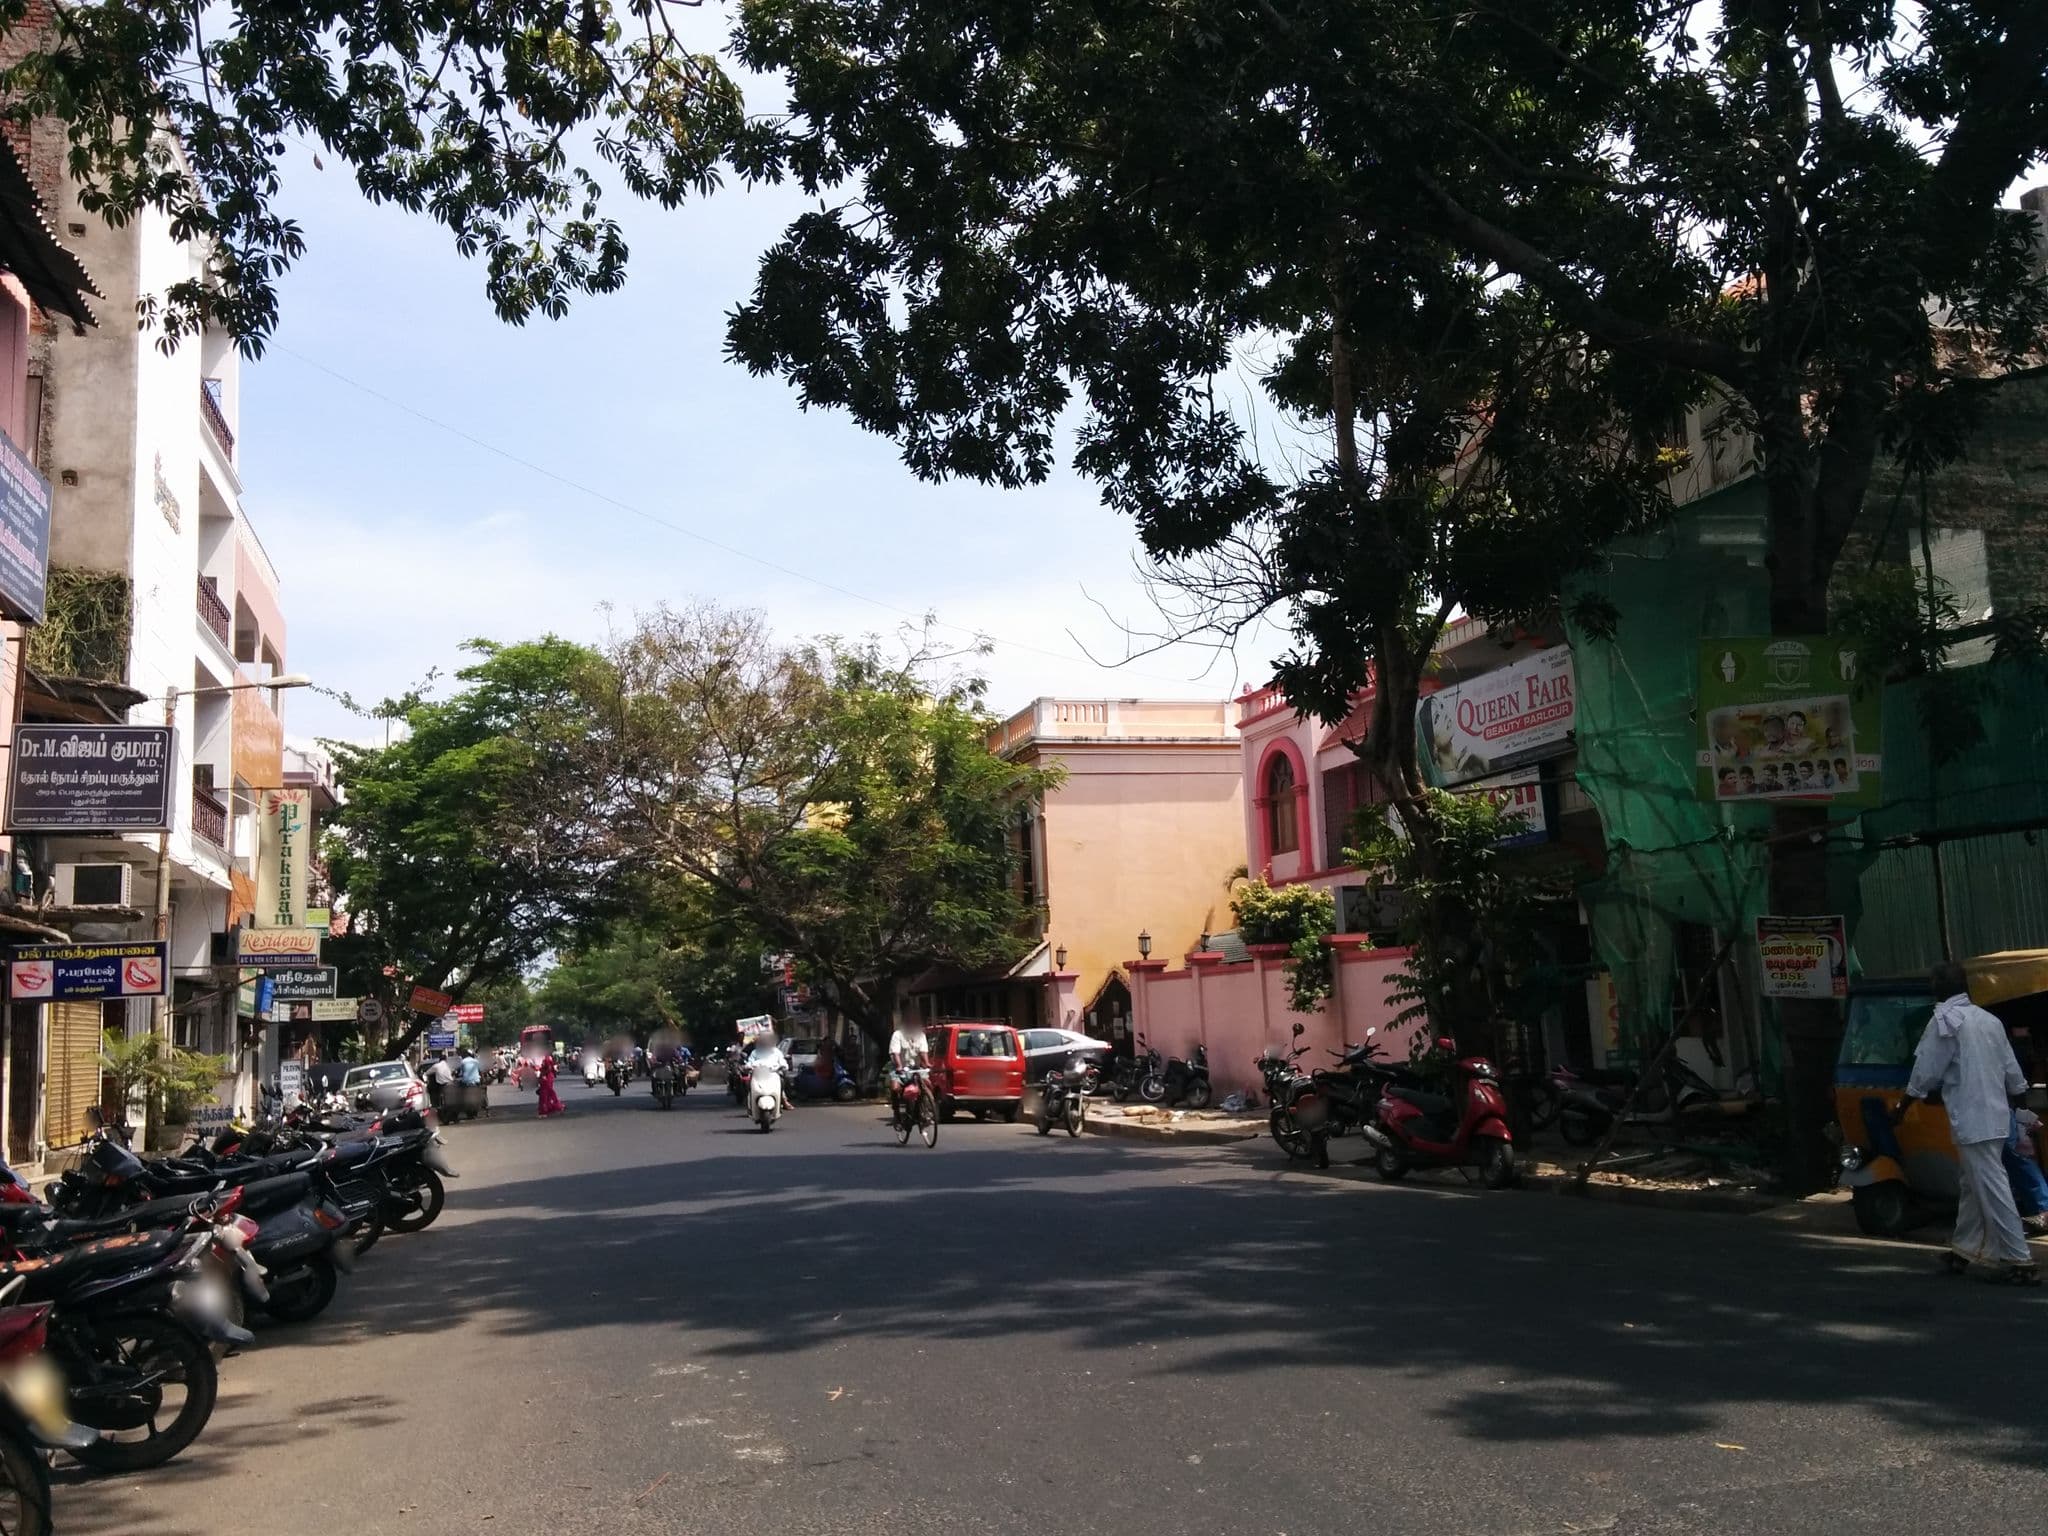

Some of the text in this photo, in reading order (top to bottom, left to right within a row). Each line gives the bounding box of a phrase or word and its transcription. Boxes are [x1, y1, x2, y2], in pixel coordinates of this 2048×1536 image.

[1456, 691, 1520, 737] QUEEN
[1525, 674, 1573, 710] FAIR
[1485, 719, 1522, 738] BEAUTY
[1523, 703, 1570, 725] PARLOUR
[20, 770, 160, 787] தோல் நோய் சிறப்பு மருத்துவர்
[274, 803, 298, 926] Prakasam
[242, 934, 316, 949] Residency
[18, 946, 156, 960] பல் மருத்துவமனை
[1770, 972, 1805, 980] CBSE
